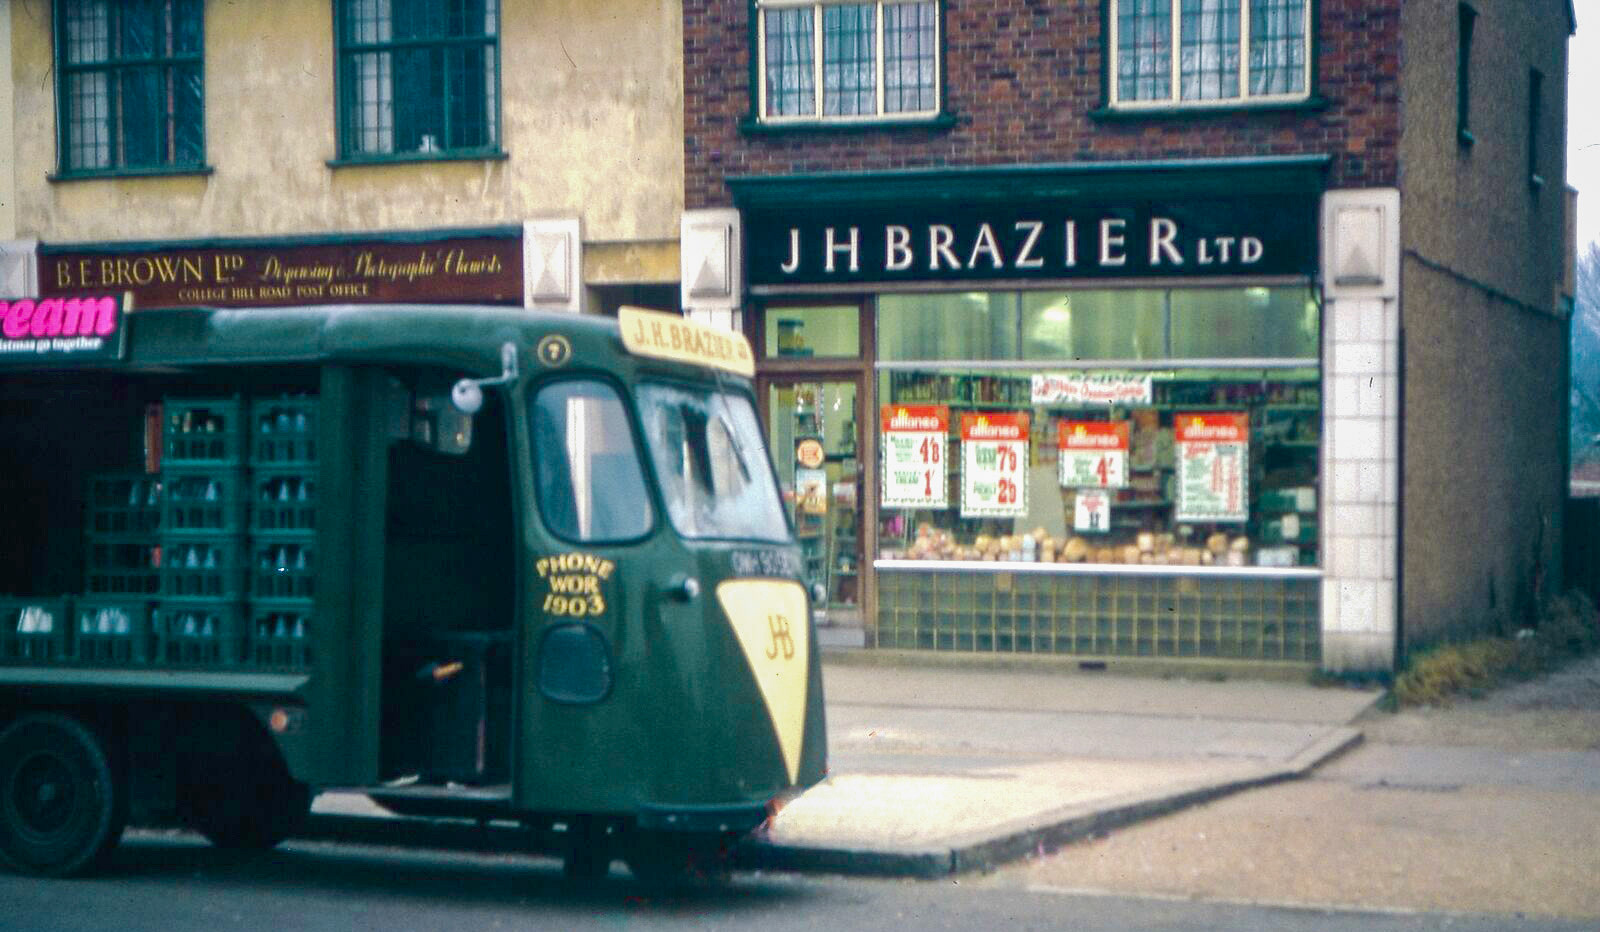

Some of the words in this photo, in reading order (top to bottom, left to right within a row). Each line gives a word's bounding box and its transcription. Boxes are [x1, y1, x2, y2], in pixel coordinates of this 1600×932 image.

[781, 228, 800, 274] J
[824, 226, 861, 272] H
[884, 217, 1184, 272] BRAZIER
[1197, 235, 1264, 265] LTD
[101, 255, 203, 284] BROWN
[354, 250, 434, 282] Photographic
[178, 287, 226, 300] COLLEGE
[232, 286, 255, 299] HILL
[259, 286, 291, 298] ROAD
[297, 285, 324, 297] POST
[330, 283, 369, 297] OFFICE
[0, 296, 117, 337] eam
[535, 552, 615, 580] PHONE
[550, 575, 599, 594] WOR
[542, 594, 606, 618] 1903
